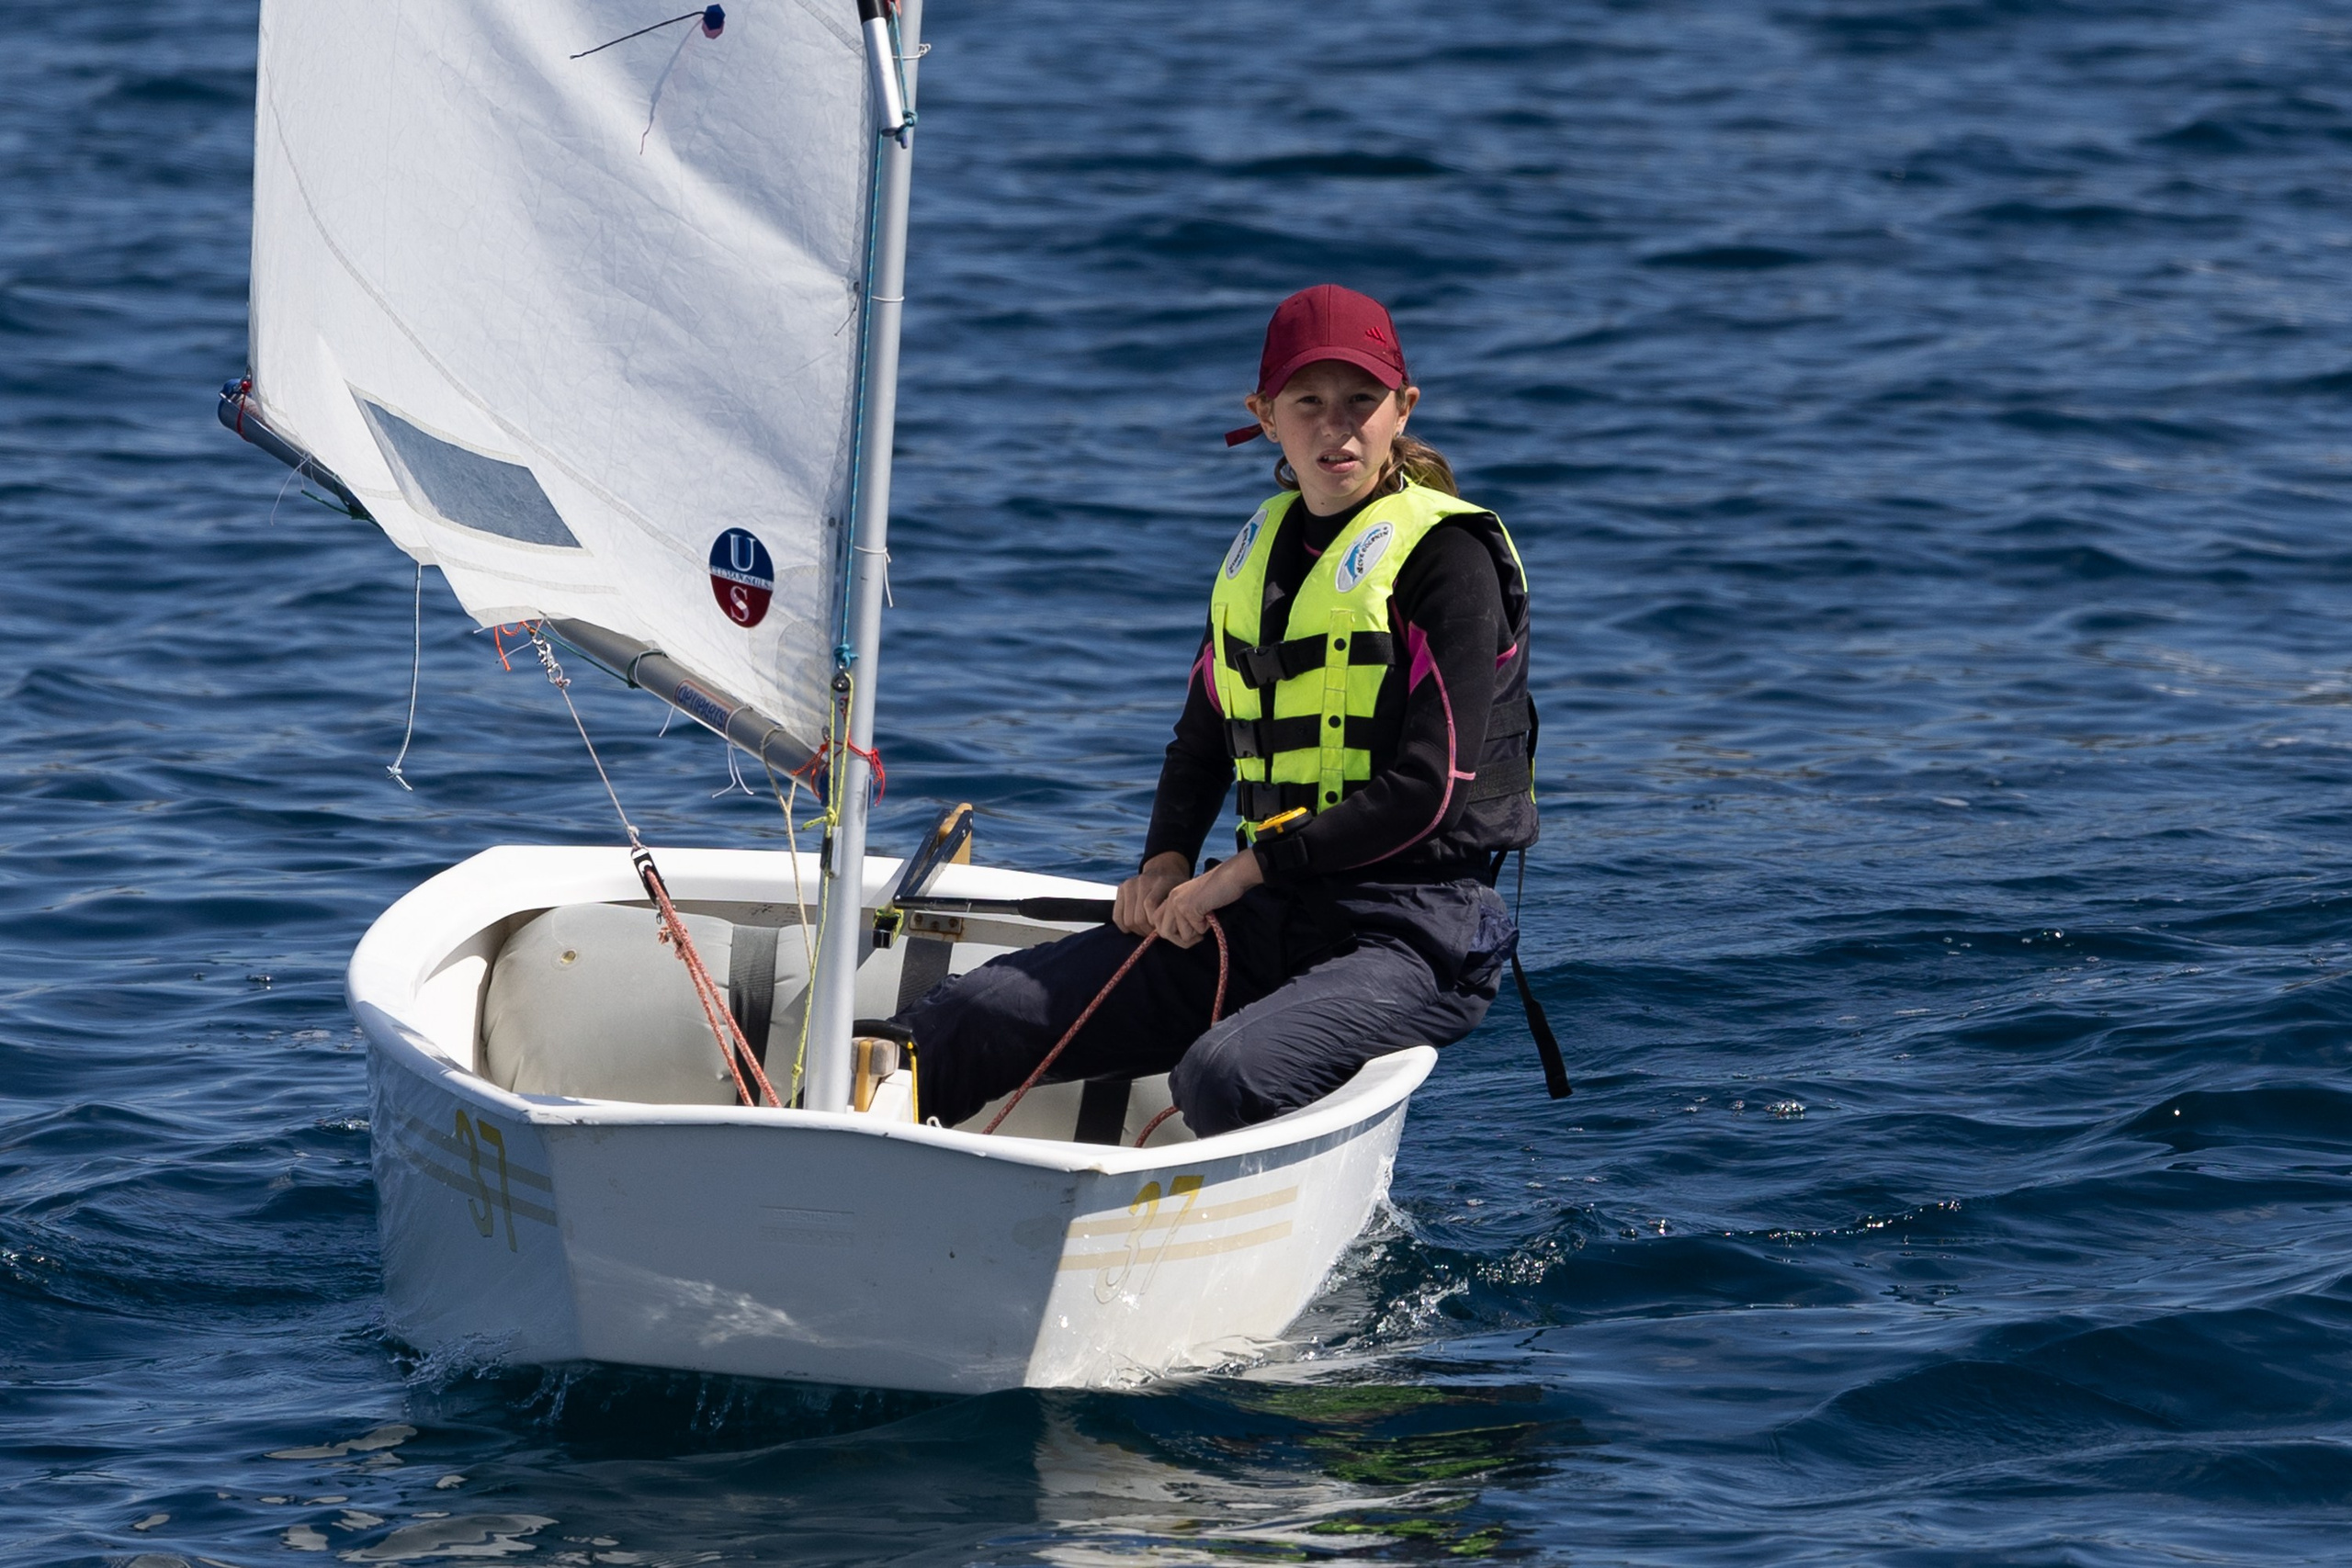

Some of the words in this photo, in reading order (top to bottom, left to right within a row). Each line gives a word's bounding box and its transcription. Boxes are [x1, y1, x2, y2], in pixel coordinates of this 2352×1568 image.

[727, 532, 756, 571] U
[729, 585, 750, 622] S
[677, 685, 729, 729] OPTIPARTS
[455, 1108, 518, 1254] 37
[1093, 1174, 1205, 1305] 37
